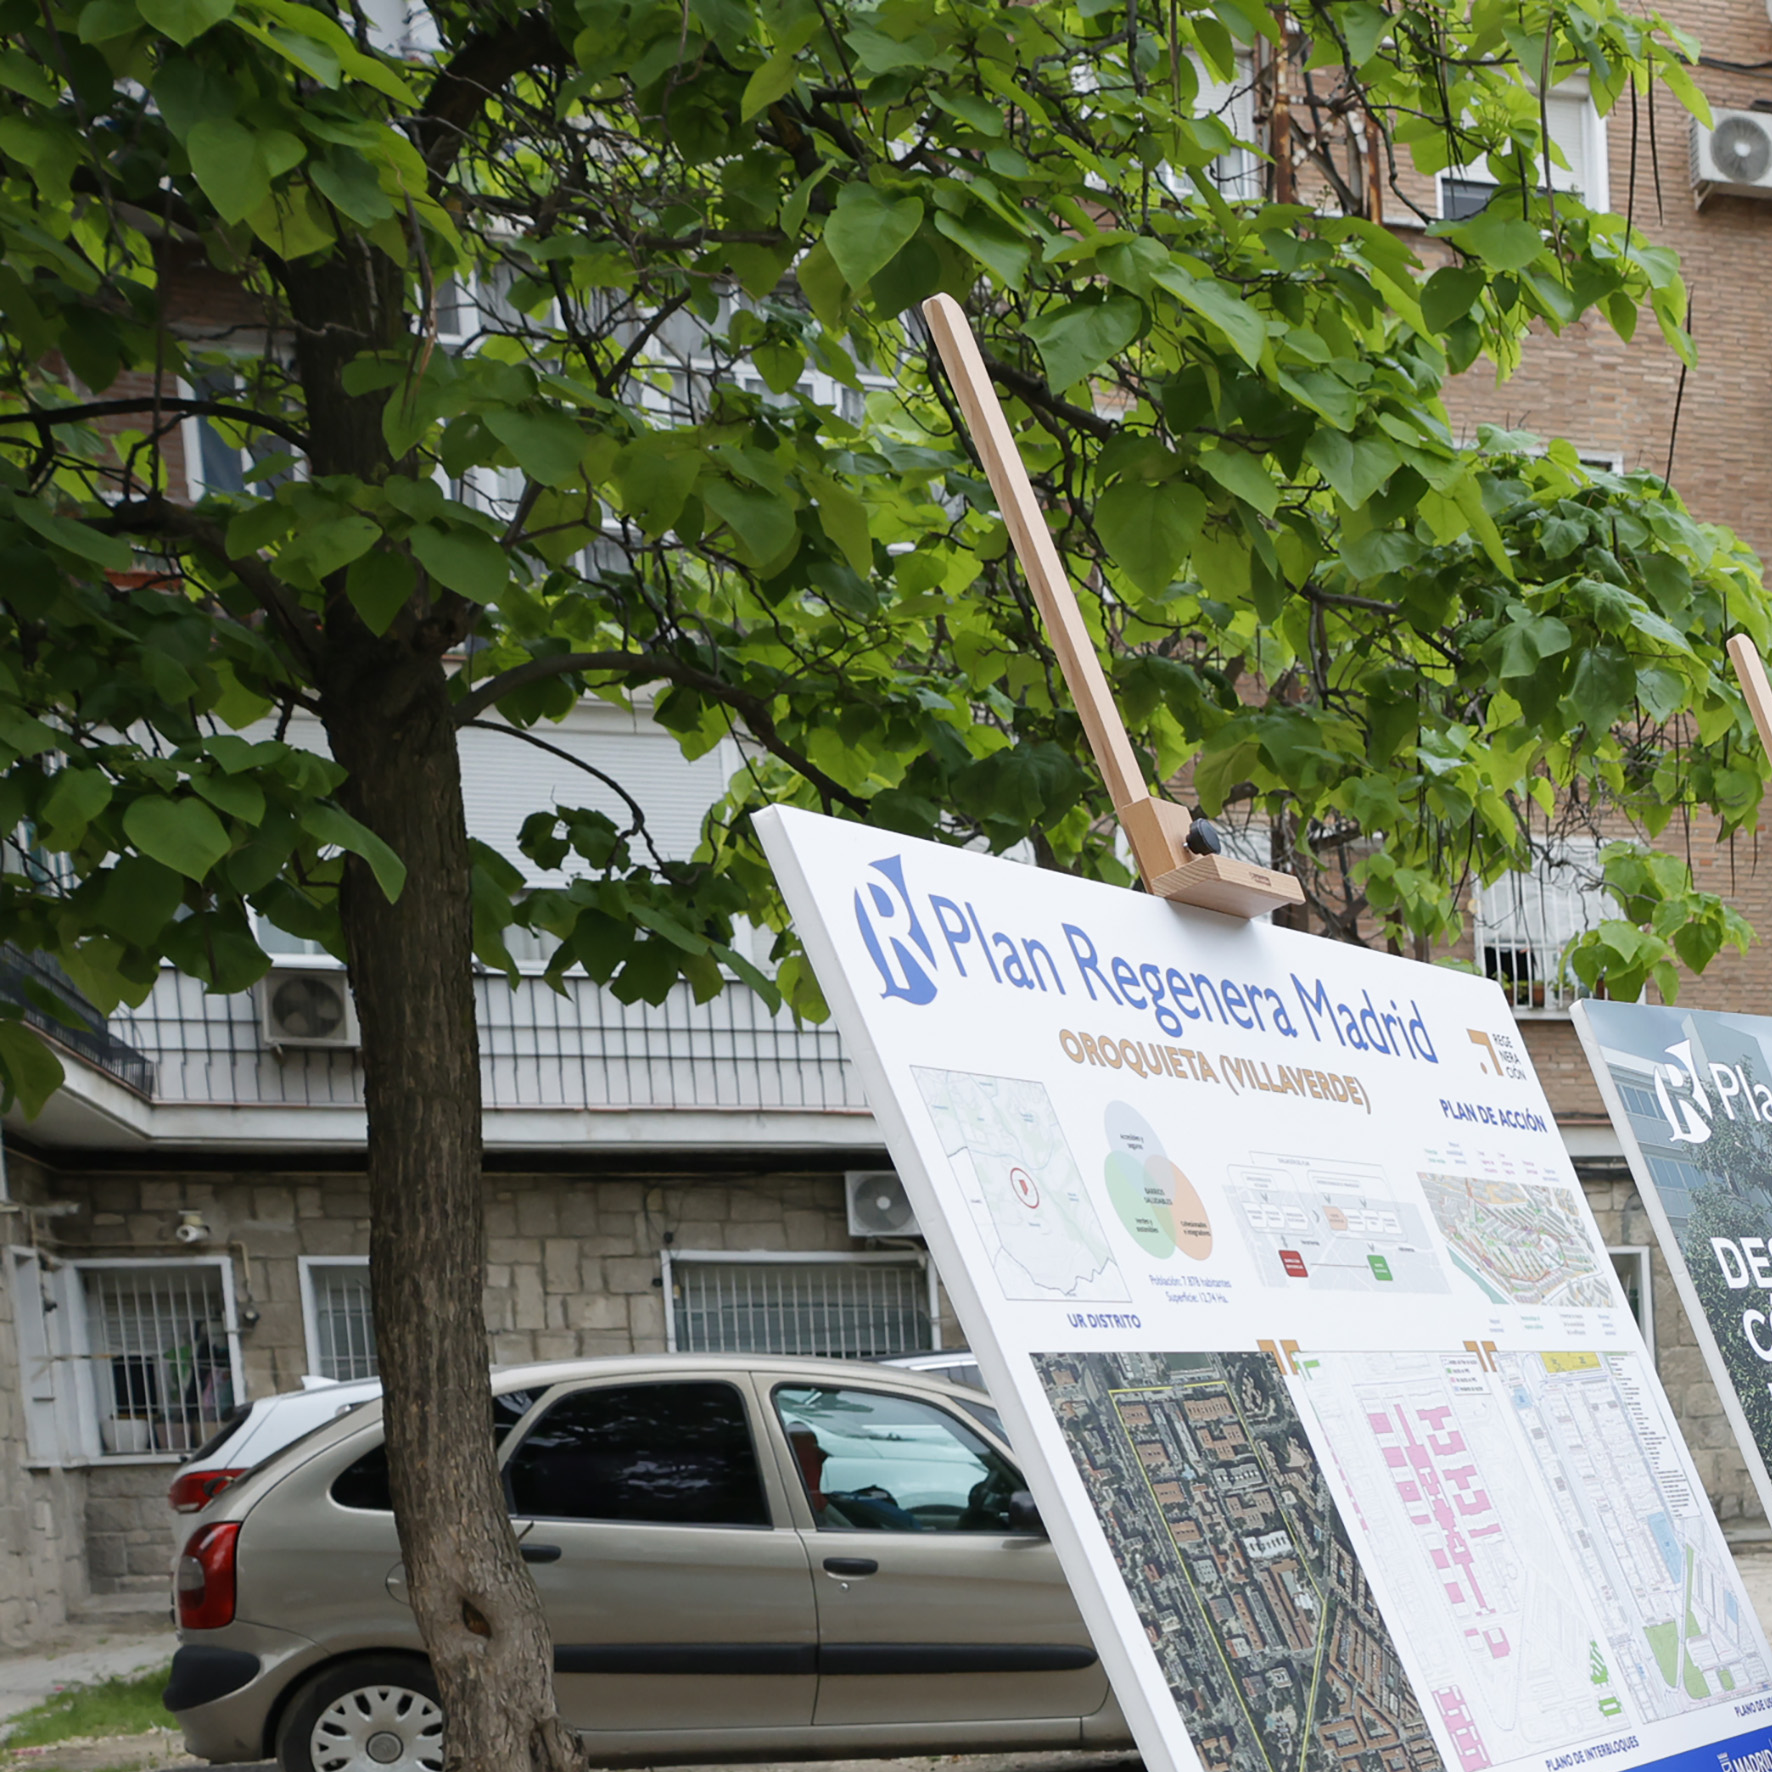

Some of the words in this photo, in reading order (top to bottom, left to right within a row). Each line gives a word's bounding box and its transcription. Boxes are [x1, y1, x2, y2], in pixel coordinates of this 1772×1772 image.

[928, 894, 1066, 995] Plan
[1061, 923, 1298, 1038] Regenera
[1290, 973, 1439, 1064] Madrid
[1491, 1033, 1514, 1049] REGE
[1498, 1049, 1521, 1065] NERA
[1060, 1029, 1219, 1083] OROQUIETA
[1220, 1055, 1371, 1114] (VILLAVERDE)
[1439, 1098, 1479, 1123] PLAN
[1476, 1104, 1498, 1126] DE
[1498, 1107, 1548, 1133] ACCIÓN
[1067, 1313, 1087, 1328] UR
[1086, 1313, 1142, 1329] DISTRITO
[1733, 1701, 1755, 1718] PLANO
[1754, 1699, 1765, 1712] DE
[1546, 1752, 1573, 1771] PLANO
[1573, 1749, 1585, 1764] DE
[1584, 1735, 1639, 1763] INTERBLOQUES
